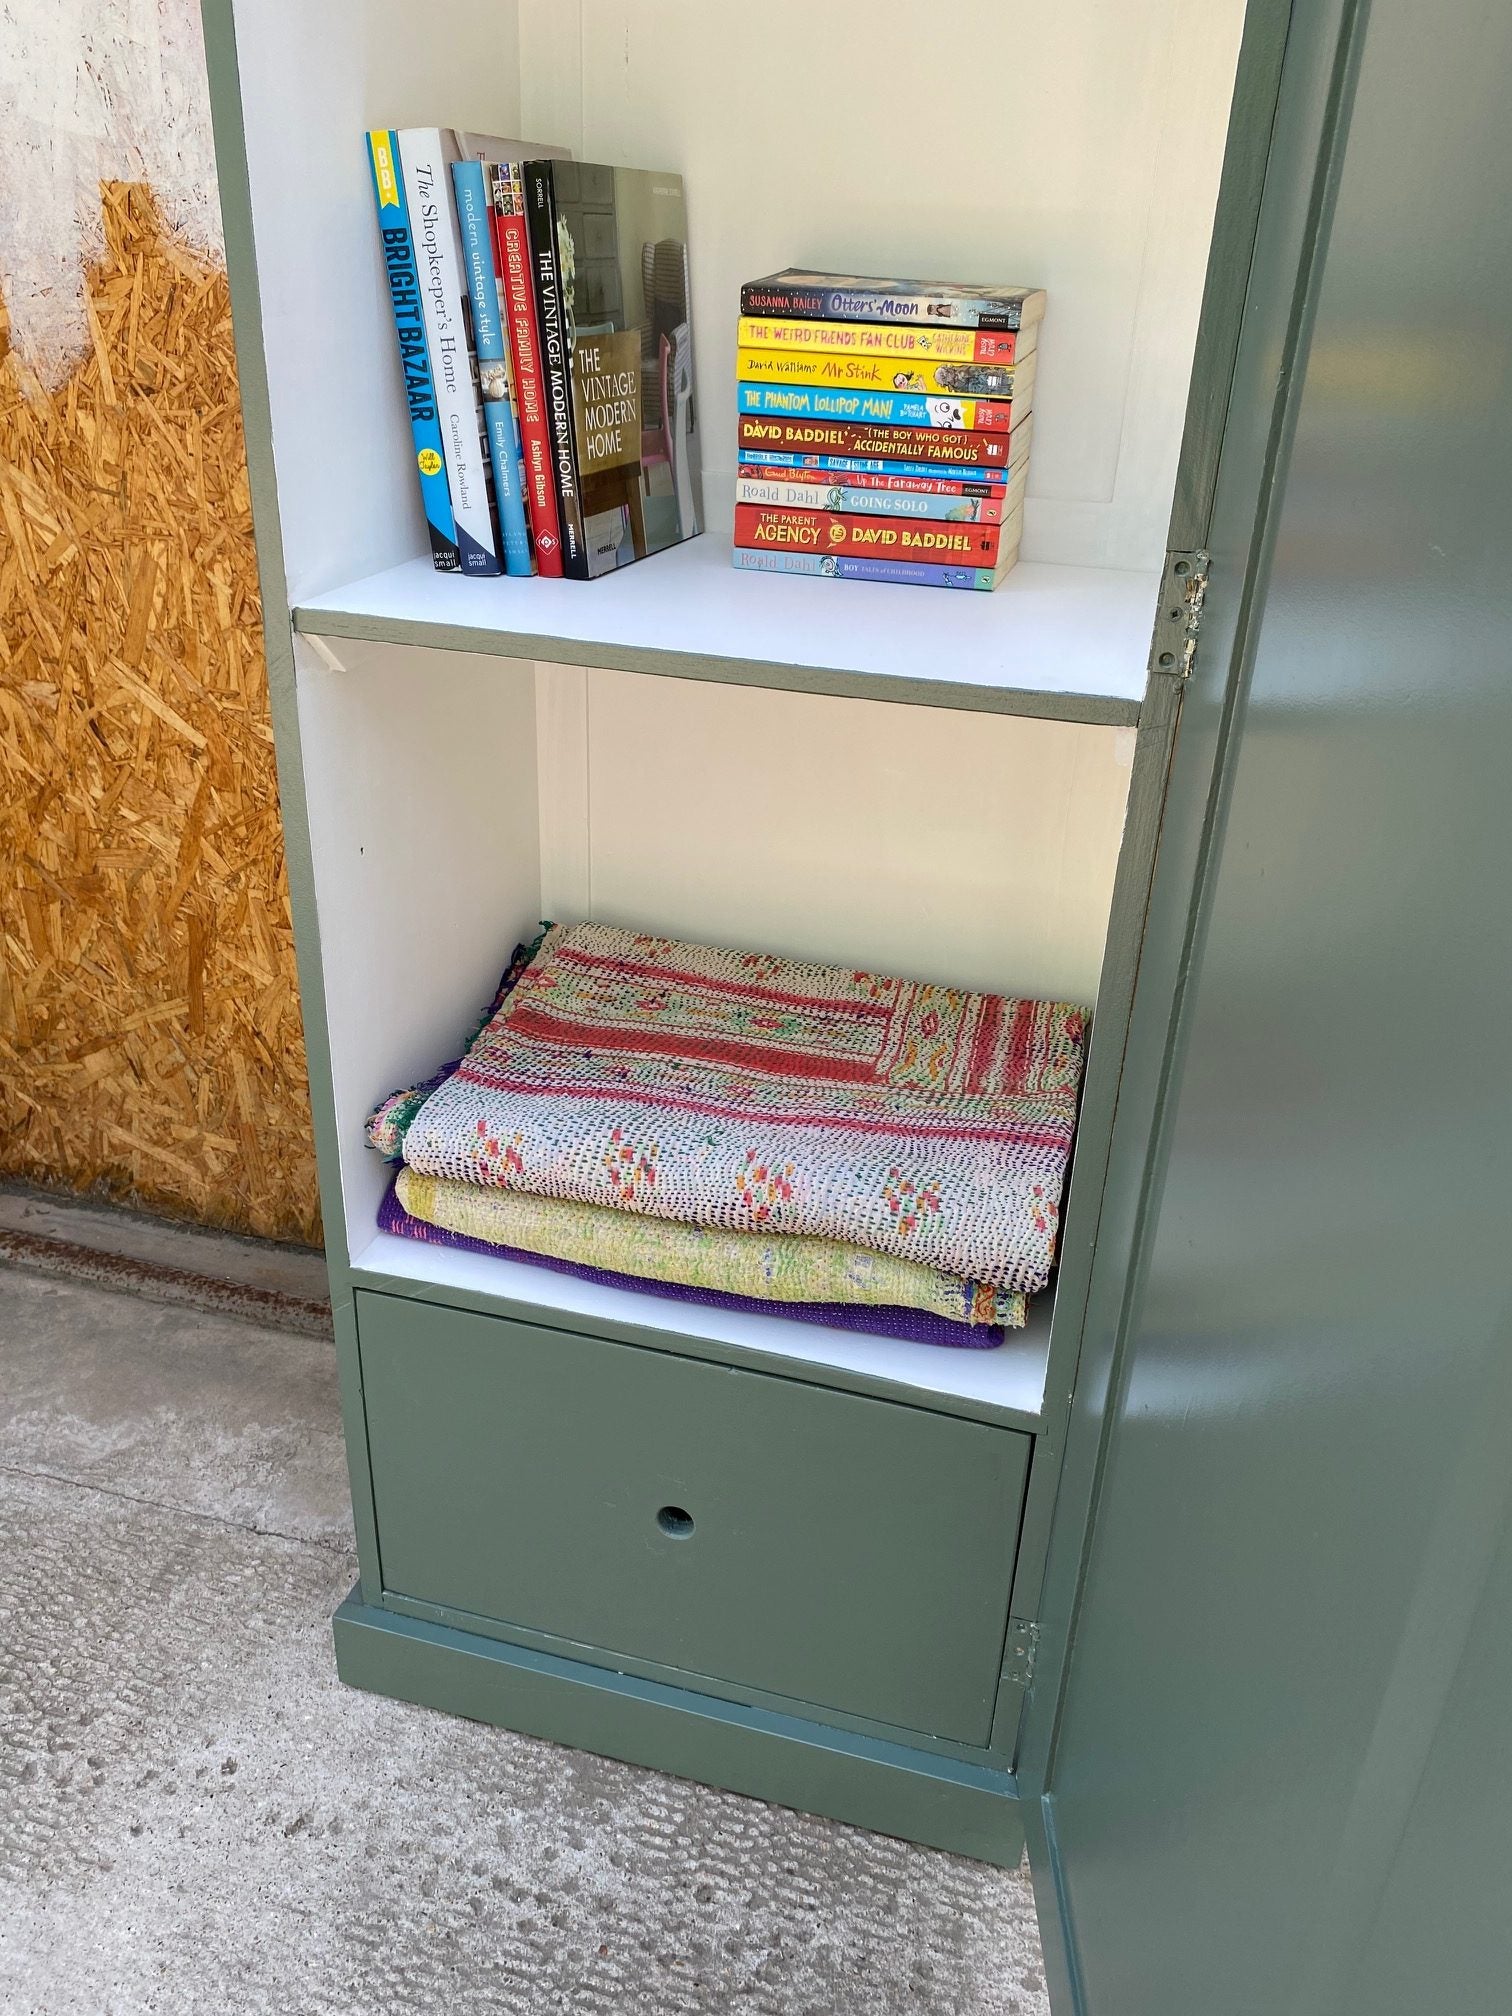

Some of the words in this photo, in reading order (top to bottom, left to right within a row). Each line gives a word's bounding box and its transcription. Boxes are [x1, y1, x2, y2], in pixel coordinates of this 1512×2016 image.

[416, 164, 432, 199] The
[535, 178, 544, 208] SORRELL
[464, 189, 481, 248] modern
[382, 227, 420, 321] BRIGHT
[422, 204, 452, 330] Shopkeeper's
[471, 251, 488, 309] vintage
[539, 250, 554, 281] THE
[750, 294, 790, 309] SUSANNA
[793, 296, 823, 310] BAILEY
[876, 298, 919, 316] Moon
[479, 312, 496, 345] style
[542, 286, 561, 366] VINTAGE
[750, 325, 769, 339] THE
[860, 332, 882, 347] FAN
[886, 333, 915, 350] CLUB
[515, 317, 534, 374] FAMILY
[398, 327, 435, 422] BAZAAR
[440, 336, 456, 393] Home
[579, 348, 601, 374] THE
[747, 359, 773, 371] David
[821, 362, 843, 378] Mr
[846, 362, 882, 382] Stink
[522, 378, 539, 423] HOME
[581, 371, 636, 402] VINTAGE
[550, 370, 568, 445] MODERN
[585, 399, 637, 431] MODERN
[744, 390, 761, 407] THE
[764, 391, 810, 412] PHANTOM
[814, 395, 859, 414] LOLLIPOP
[861, 398, 894, 420] MAN!
[586, 430, 622, 460] HOME
[743, 423, 781, 439] DAVID
[785, 428, 845, 445] BADDIEL
[893, 431, 912, 440] BOY
[916, 432, 940, 443] WHO
[450, 414, 462, 461] Caroline
[456, 463, 472, 510] Rowland
[495, 421, 503, 448] Emily
[499, 451, 511, 497] Chalmers
[531, 439, 543, 472] Ashlyn
[853, 439, 925, 456] ACCIDENTALLY
[927, 445, 979, 461] FAMOUS
[558, 450, 574, 497] HOME
[789, 469, 817, 481] Blyton
[857, 475, 868, 486] Up
[871, 475, 885, 487] The
[887, 475, 933, 492] Faraway
[937, 481, 956, 493] Tree
[534, 473, 546, 507] Gibson
[742, 484, 779, 501] Roald
[787, 489, 819, 504] Dahl
[851, 495, 891, 510] GOING
[894, 500, 928, 513] SOLO
[754, 523, 822, 545] AGENCY
[760, 513, 779, 523] THE
[781, 515, 817, 526] PARENT
[567, 523, 577, 559] MERRELL
[852, 528, 898, 545] DAVID
[901, 531, 972, 551] BADDIEL
[433, 551, 455, 560] jacqui
[434, 559, 456, 568] small
[467, 552, 486, 561] jacqui
[741, 553, 777, 568] Roald
[784, 556, 816, 570] Dahl
[844, 564, 859, 572] BOY
